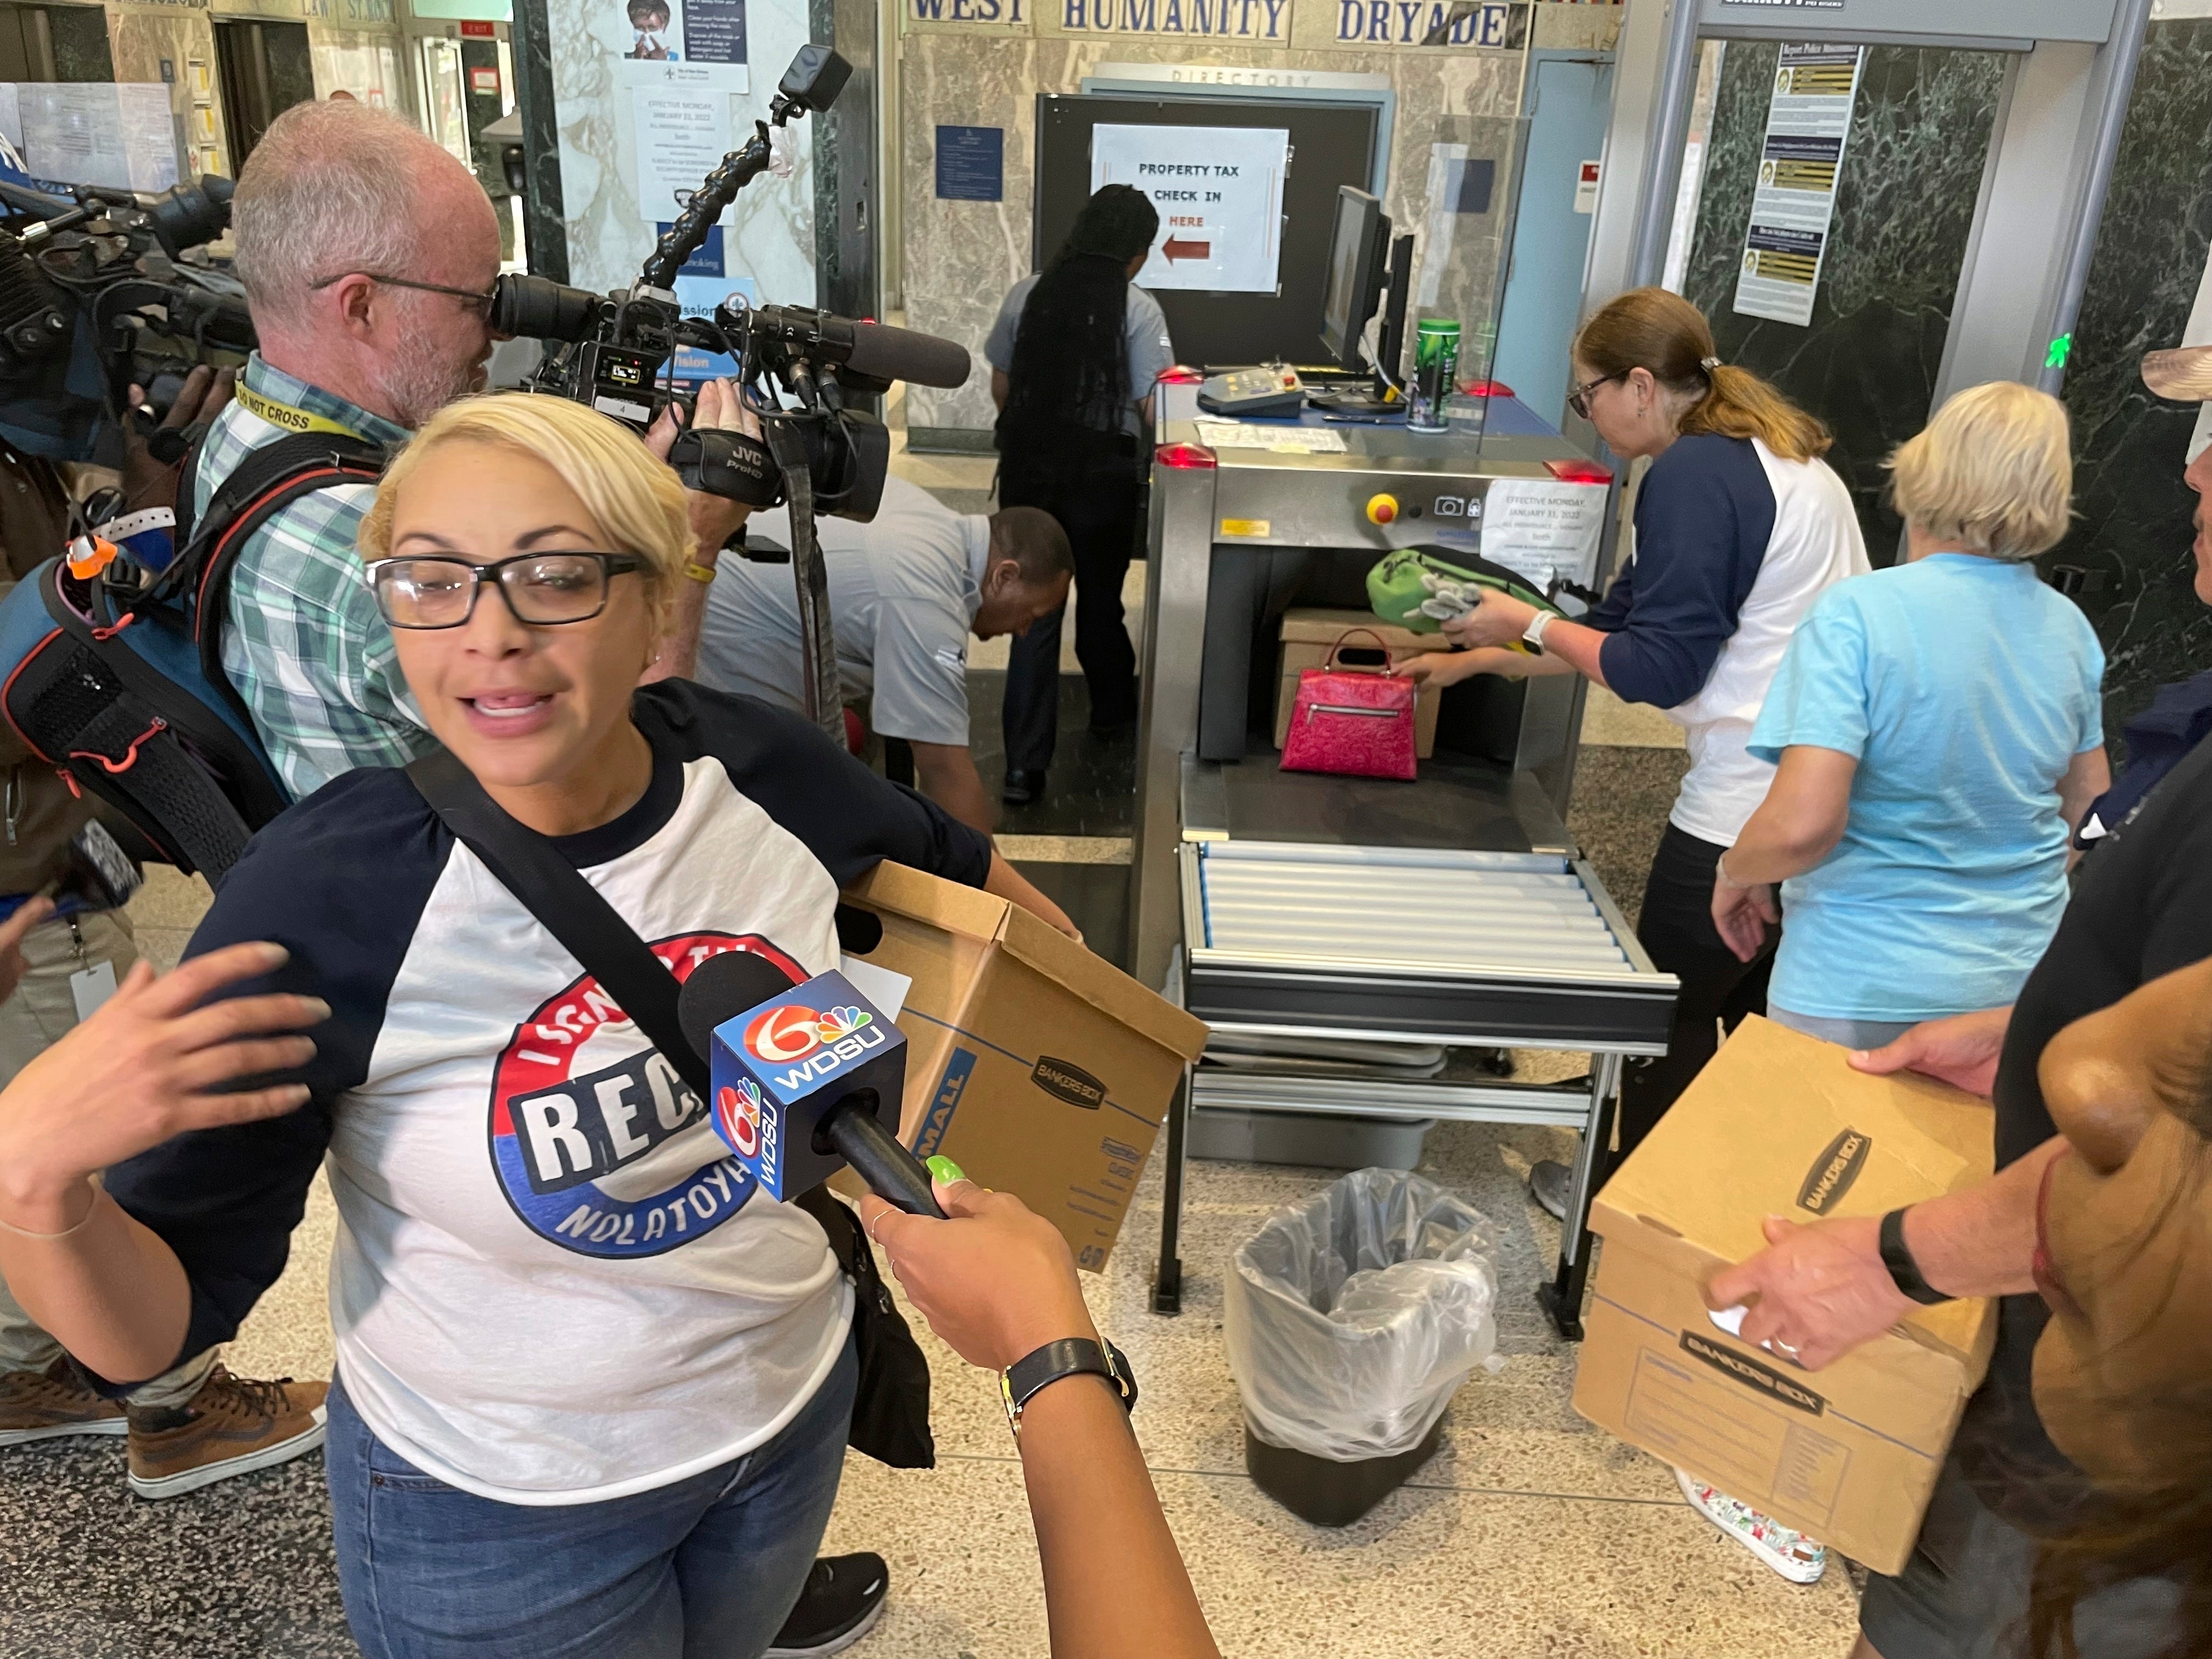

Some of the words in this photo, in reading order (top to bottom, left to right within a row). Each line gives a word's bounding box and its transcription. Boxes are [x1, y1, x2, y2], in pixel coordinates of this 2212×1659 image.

[1064, 0, 1287, 38] HUMANITY
[1172, 70, 1311, 88] DIRECTORY
[1139, 163, 1210, 176] PROPERTY
[1214, 166, 1239, 177] TAX
[1154, 190, 1198, 201] CHECK
[1205, 191, 1222, 203] IN
[1169, 216, 1204, 227] HERE
[249, 396, 266, 415] NOT
[268, 406, 310, 429] CROSS
[732, 445, 762, 467] JVC
[726, 459, 763, 479] ProHD
[1506, 495, 1546, 505] EFFECTIVE
[1509, 509, 1545, 517] JANUARY
[756, 1008, 823, 1061] 6
[518, 1049, 560, 1066] I
[774, 1025, 886, 1090] WDSU
[1037, 1064, 1083, 1093] BANKERS
[1080, 1084, 1103, 1101] BOX
[720, 1091, 757, 1156] 6
[761, 1098, 778, 1186] WDSU
[1838, 1135, 1863, 1159] BOX
[1775, 1380, 1817, 1411] BOX
